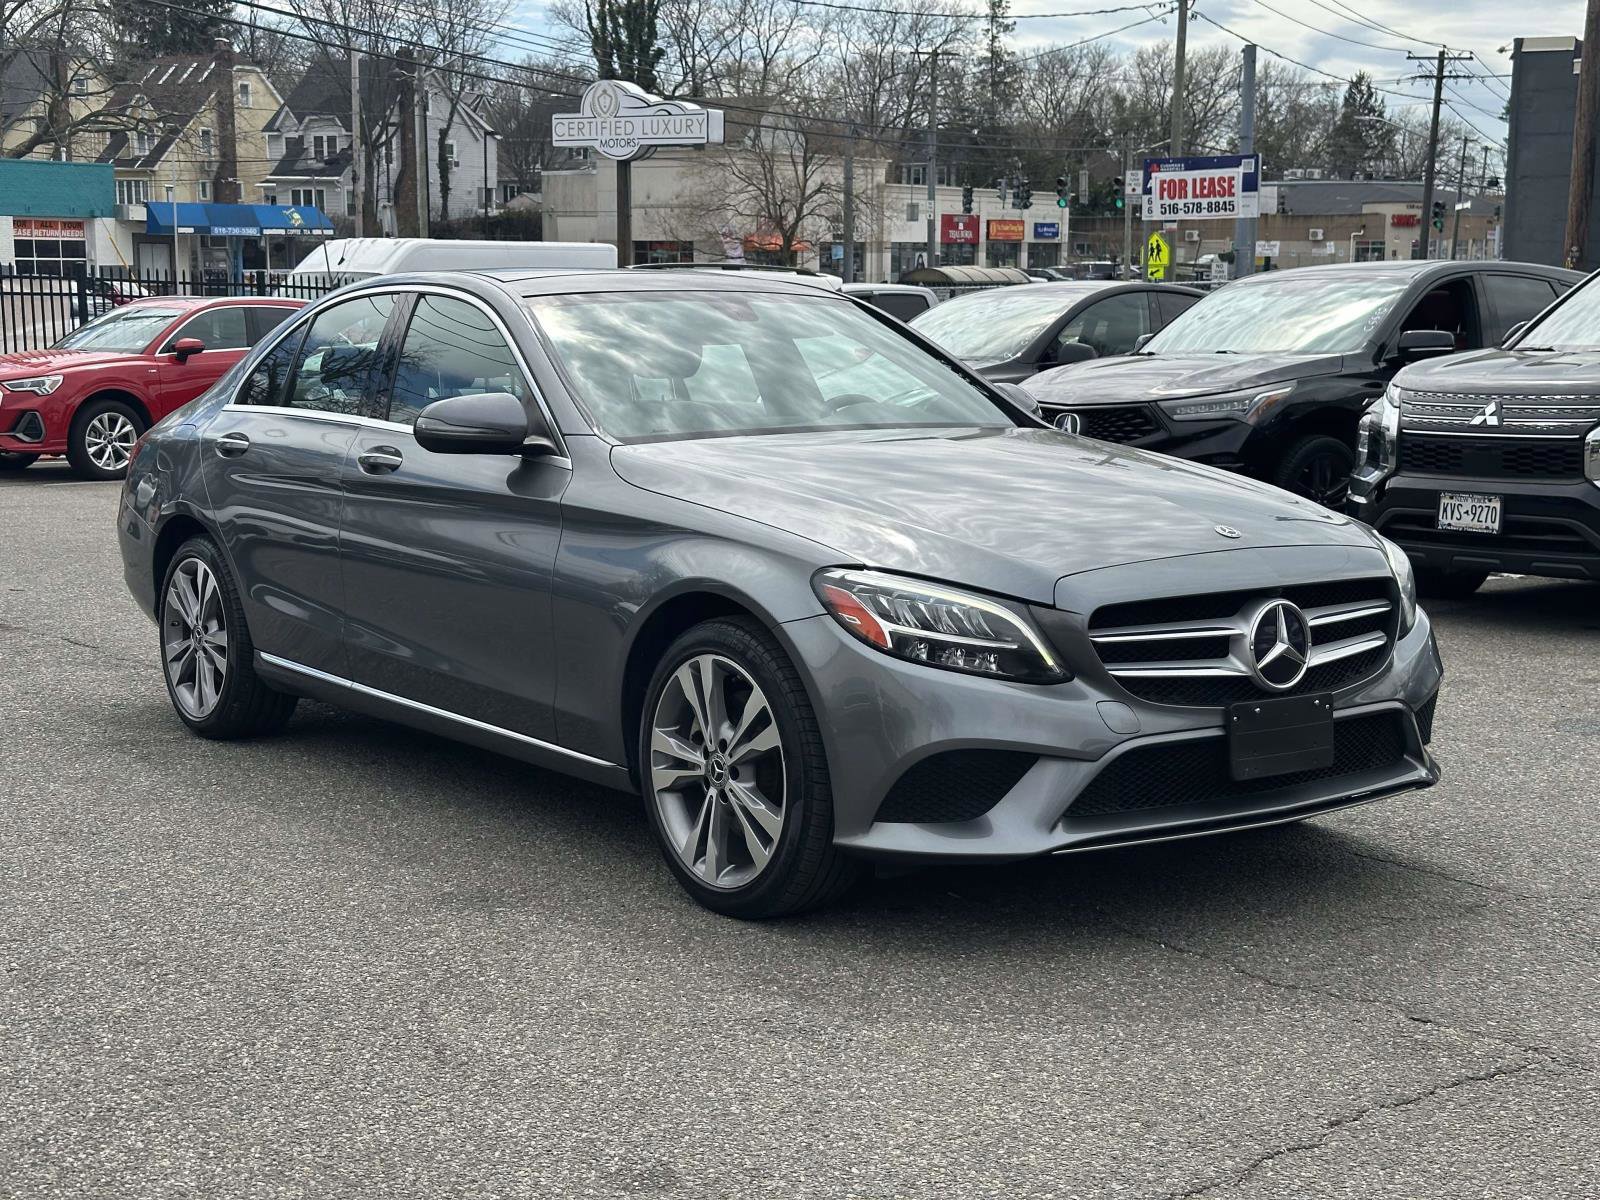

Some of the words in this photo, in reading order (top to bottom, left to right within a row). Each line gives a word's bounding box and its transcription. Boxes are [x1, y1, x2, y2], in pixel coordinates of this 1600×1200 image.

[554, 121, 634, 137] CERTIFIED
[642, 118, 705, 135] LUXURY
[600, 139, 636, 149] MOTORS
[1159, 178, 1188, 200] FOR
[1191, 176, 1235, 198] LEASE
[1160, 200, 1235, 216] 516-578-8845
[40, 219, 53, 228] ALL
[63, 220, 82, 229] YOUR
[34, 229, 59, 237] RETURN
[61, 229, 84, 237] NEEDS
